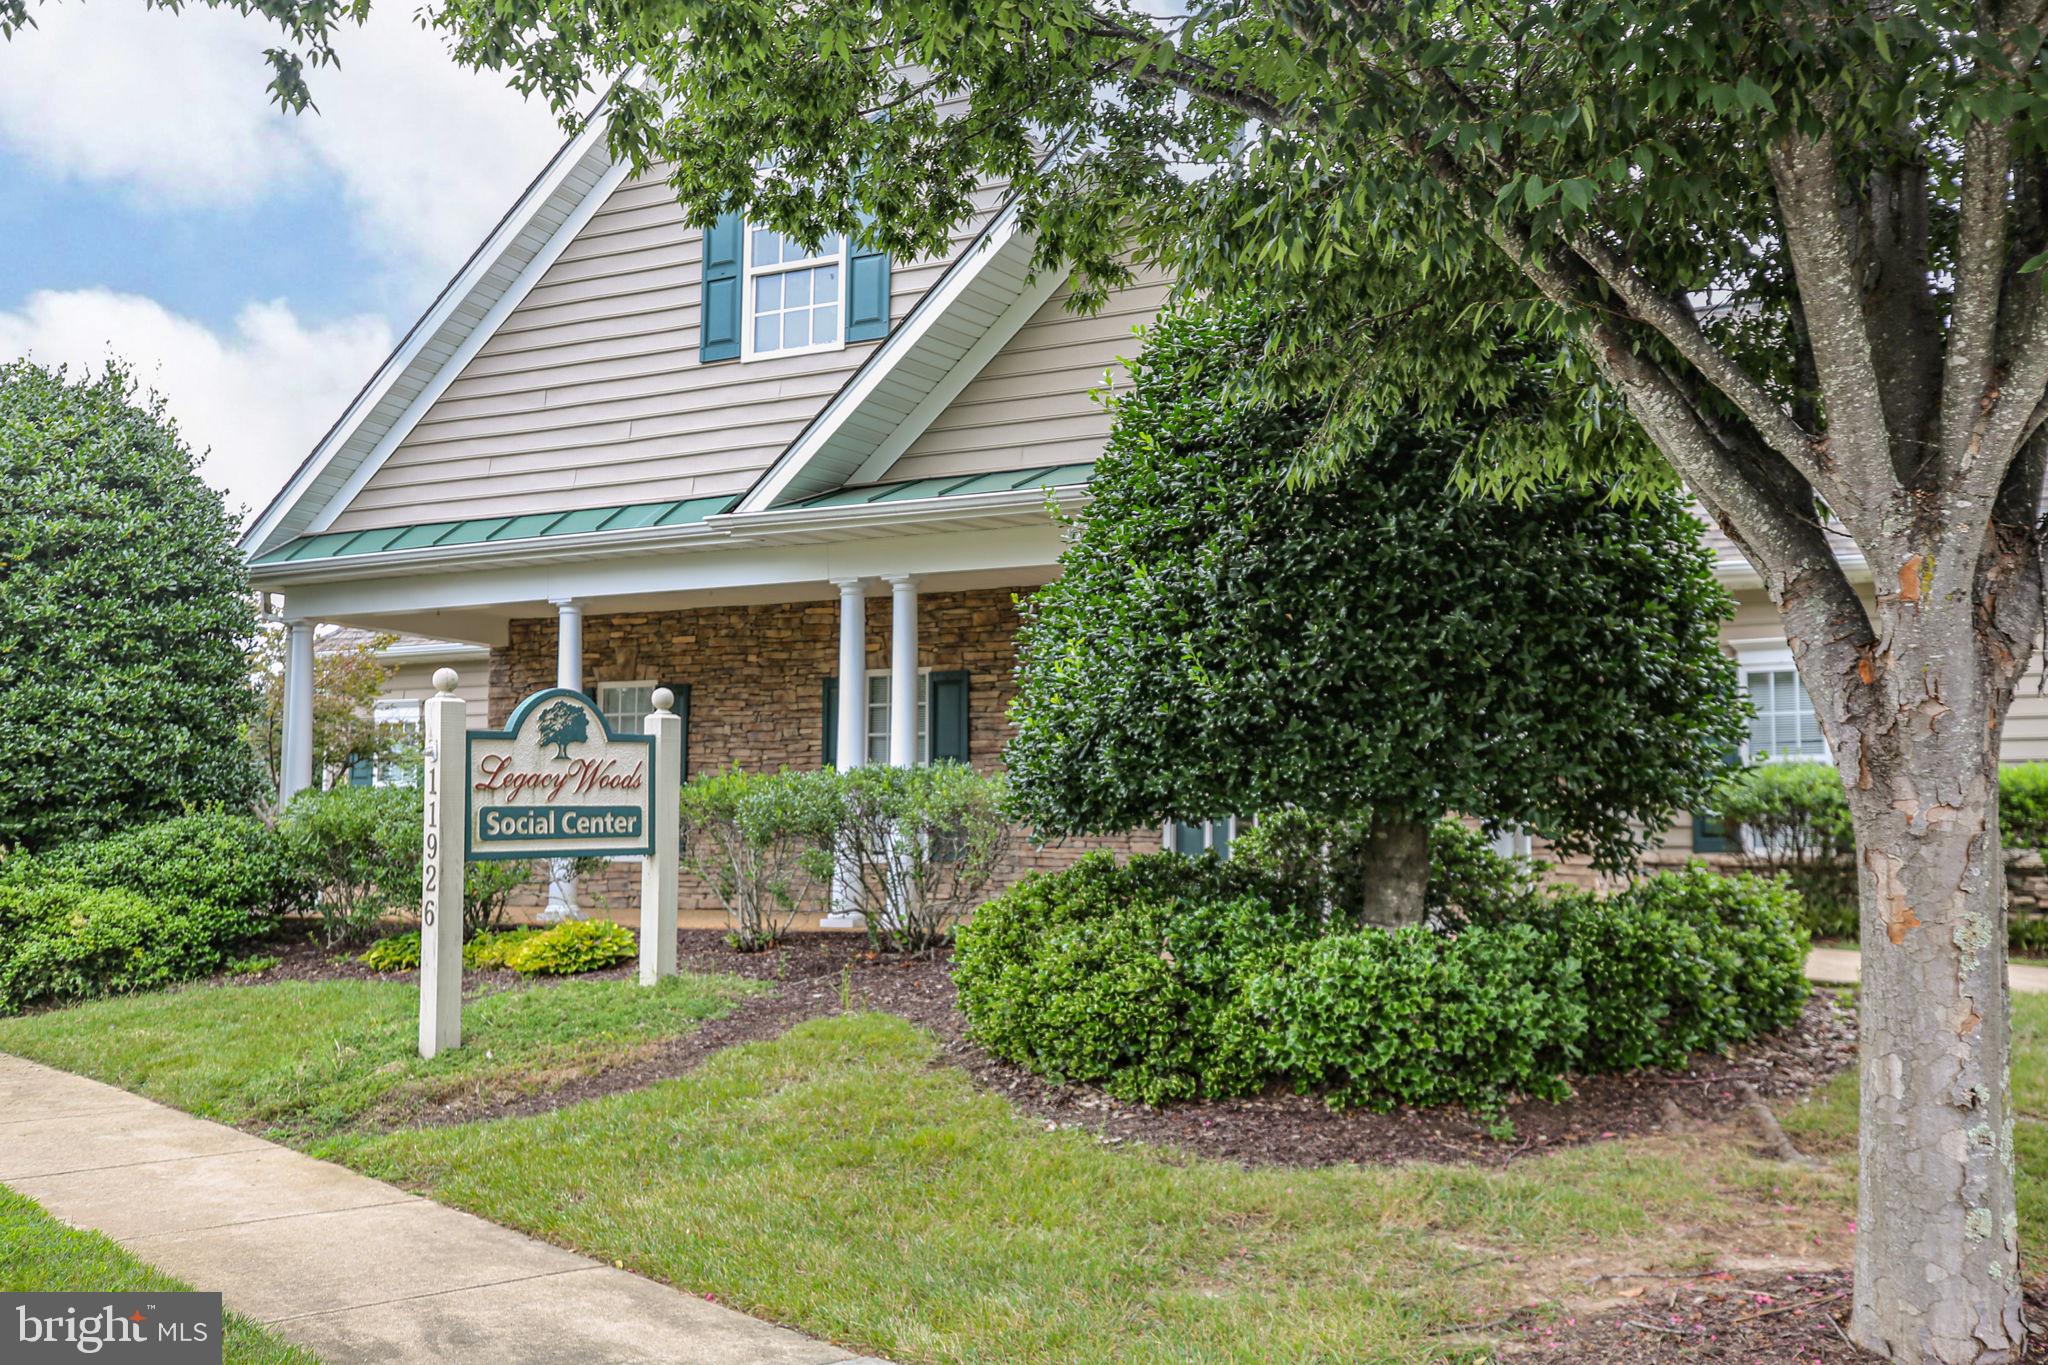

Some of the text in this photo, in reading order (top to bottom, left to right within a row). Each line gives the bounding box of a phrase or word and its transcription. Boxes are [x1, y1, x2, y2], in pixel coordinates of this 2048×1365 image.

[475, 755, 643, 802] Legacy Woods
[486, 810, 637, 836] Social Center
[424, 768, 438, 927] 11926
